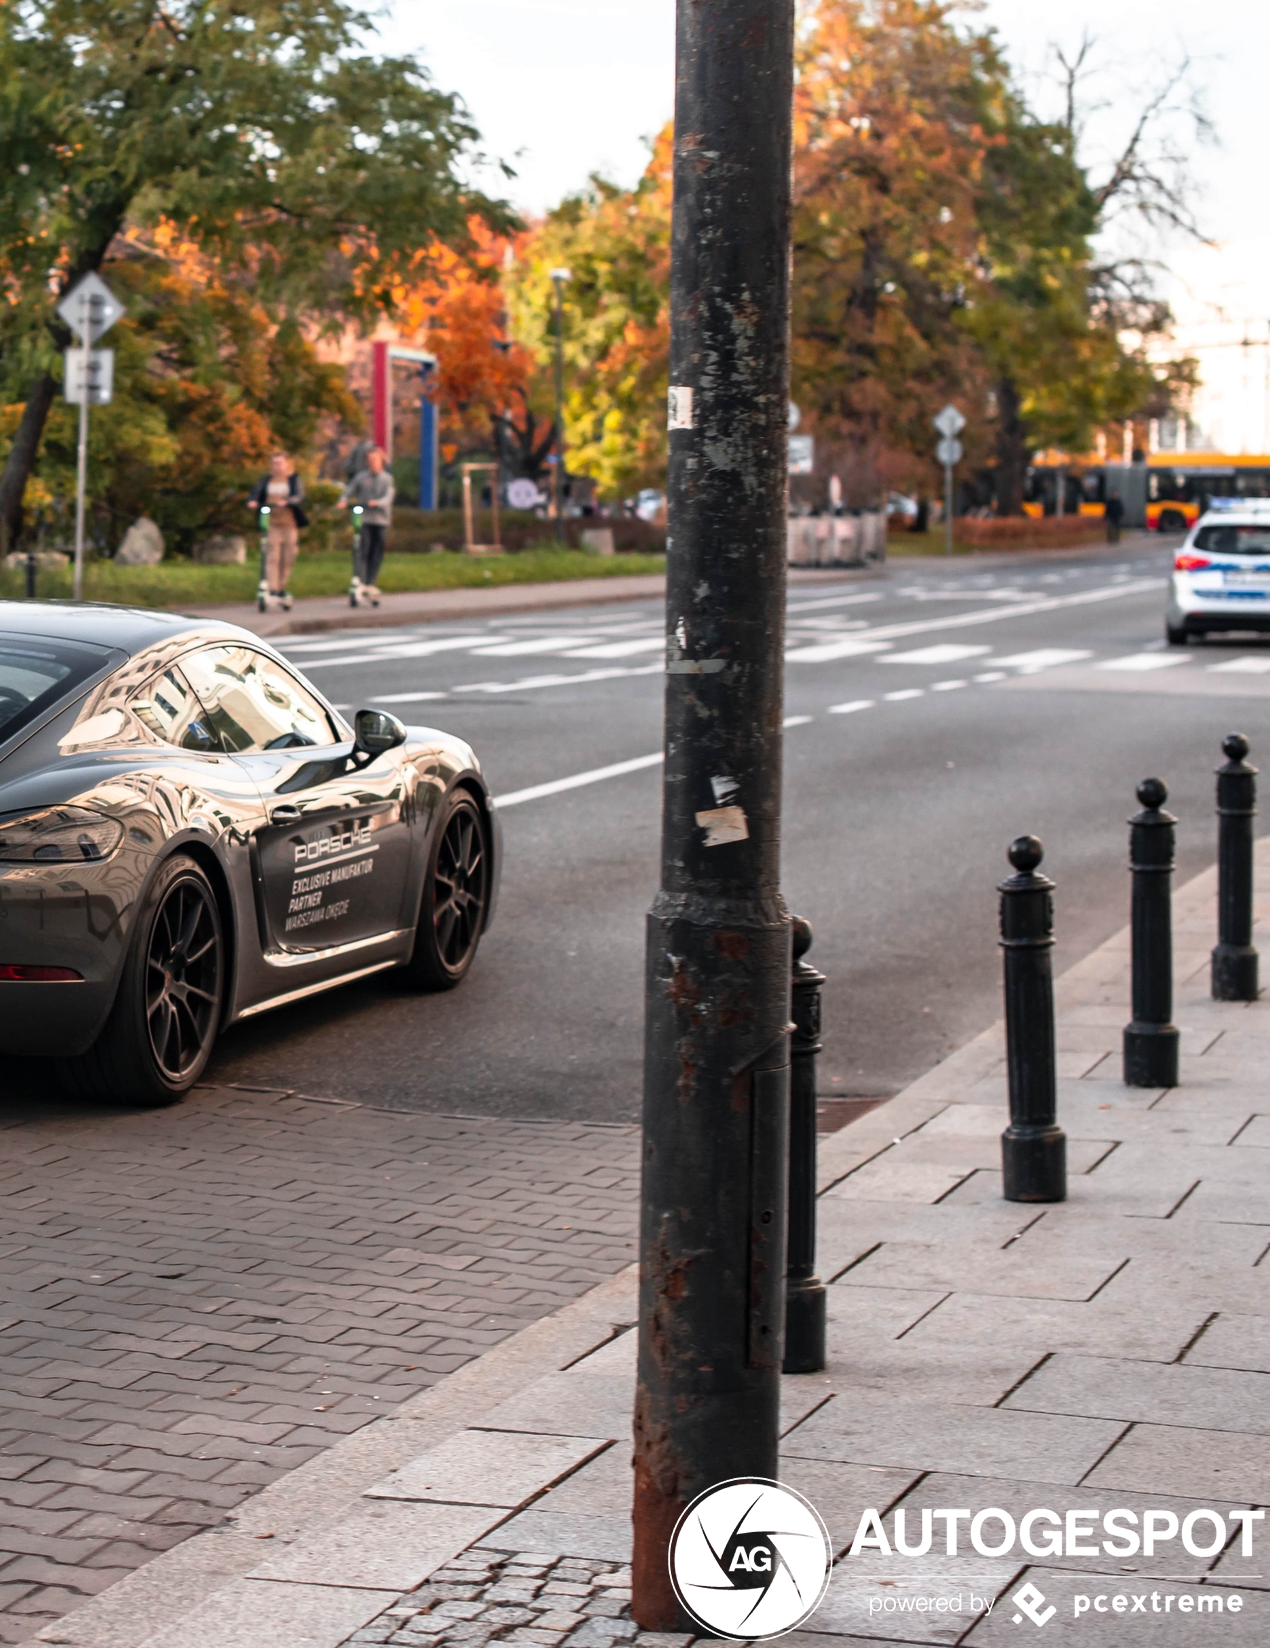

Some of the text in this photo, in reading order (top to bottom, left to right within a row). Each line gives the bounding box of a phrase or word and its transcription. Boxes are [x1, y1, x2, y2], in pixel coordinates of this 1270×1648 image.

[295, 828, 371, 862] PORSCHE
[292, 859, 373, 895] EXCLUSIVE MANUFAKTUR
[285, 899, 350, 931] WARSZAWA OKĘCIE
[288, 891, 322, 913] PARTNER
